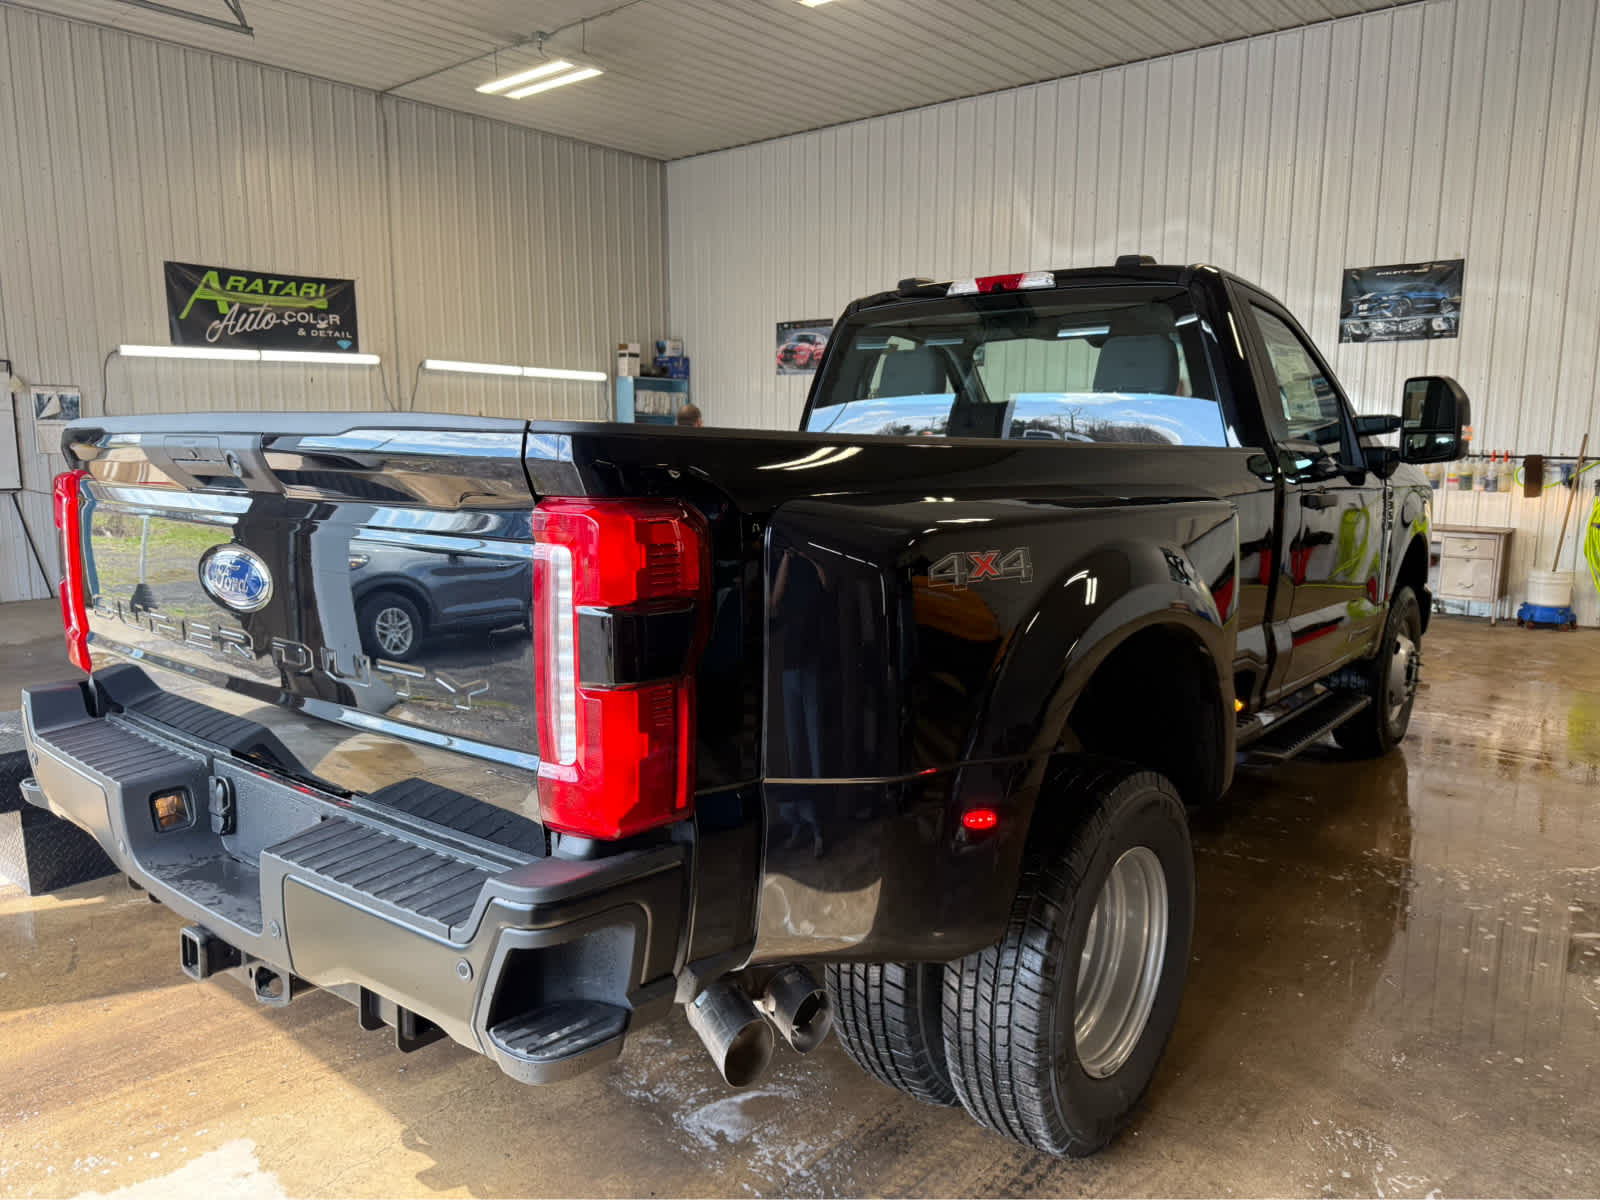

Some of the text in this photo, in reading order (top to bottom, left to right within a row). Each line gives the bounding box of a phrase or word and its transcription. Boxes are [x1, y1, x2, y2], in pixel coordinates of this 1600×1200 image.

[179, 271, 326, 319] ARATARI
[206, 302, 281, 343] Auto
[297, 327, 352, 338] & DETAIL
[208, 562, 249, 594] Ford
[94, 595, 489, 710] SUPER DUTY
